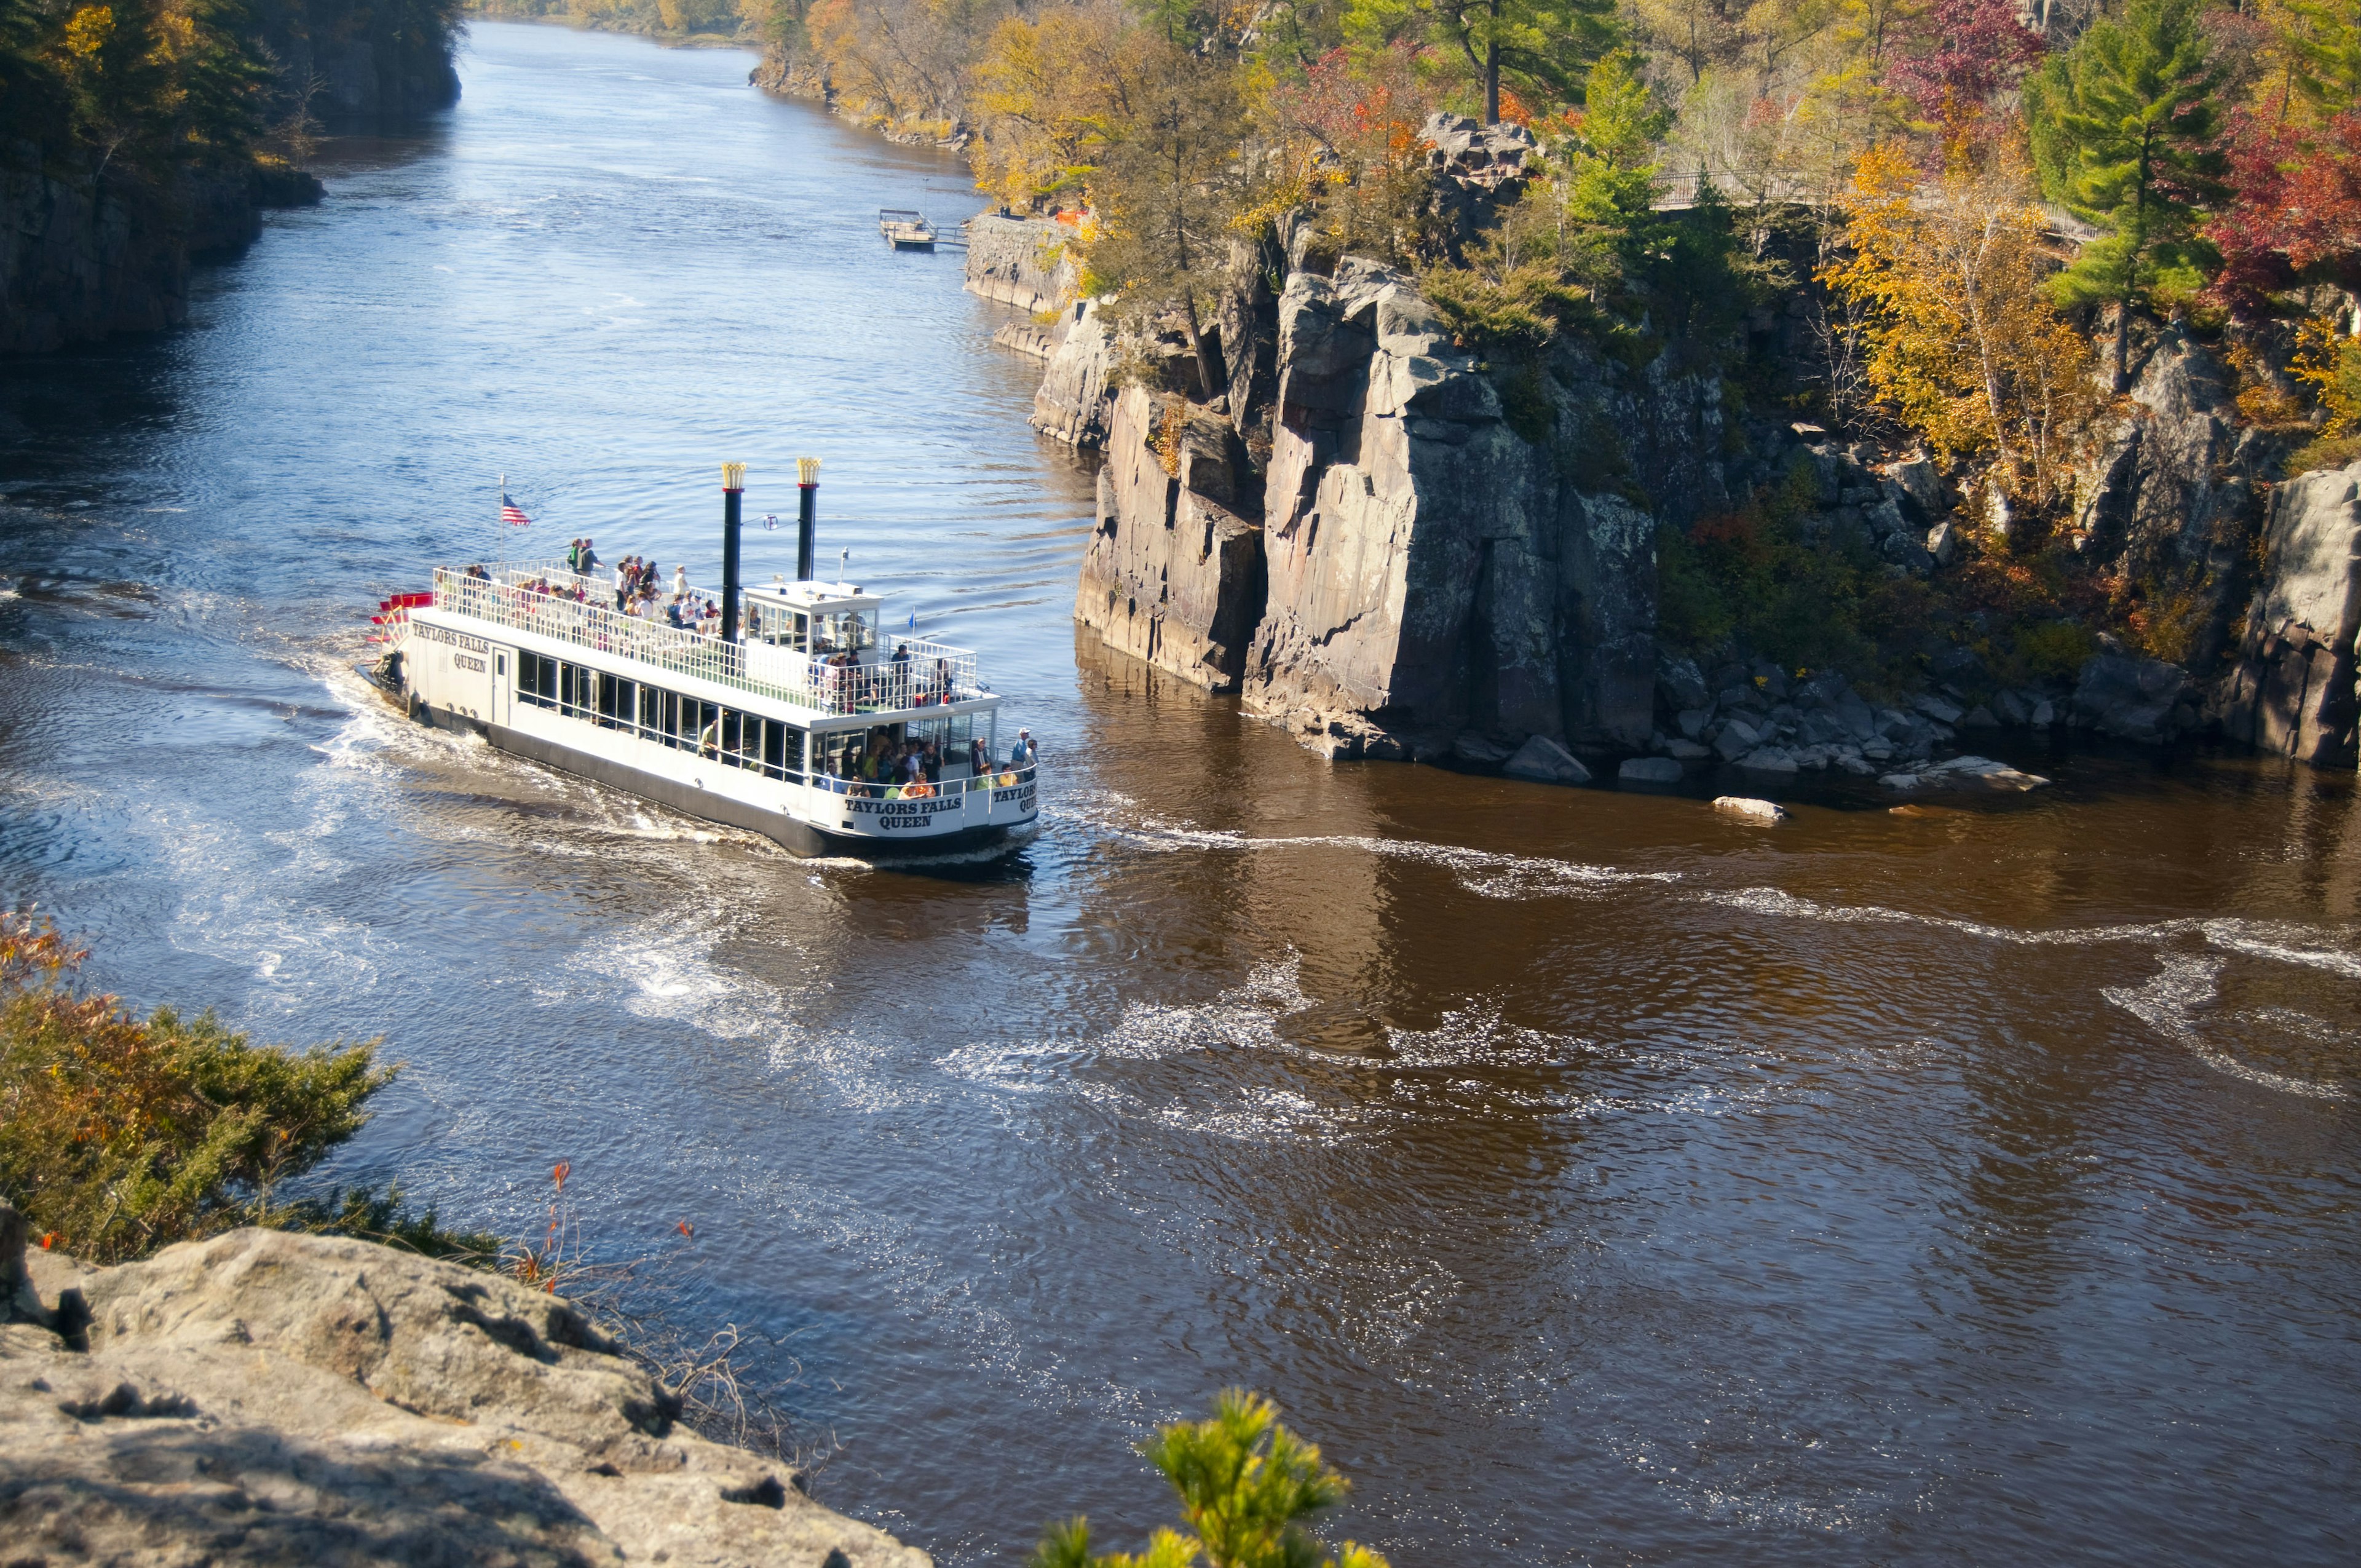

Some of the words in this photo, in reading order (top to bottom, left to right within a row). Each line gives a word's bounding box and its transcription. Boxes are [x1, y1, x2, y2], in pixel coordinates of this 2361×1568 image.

[413, 624, 457, 646] TAYLORS
[459, 635, 489, 654] FALLS
[454, 653, 486, 673] QUEEN
[845, 799, 918, 815] TAYLORS
[920, 798, 961, 814] FALLS
[1019, 796, 1036, 813] QUE
[879, 815, 932, 830] QUEEN
